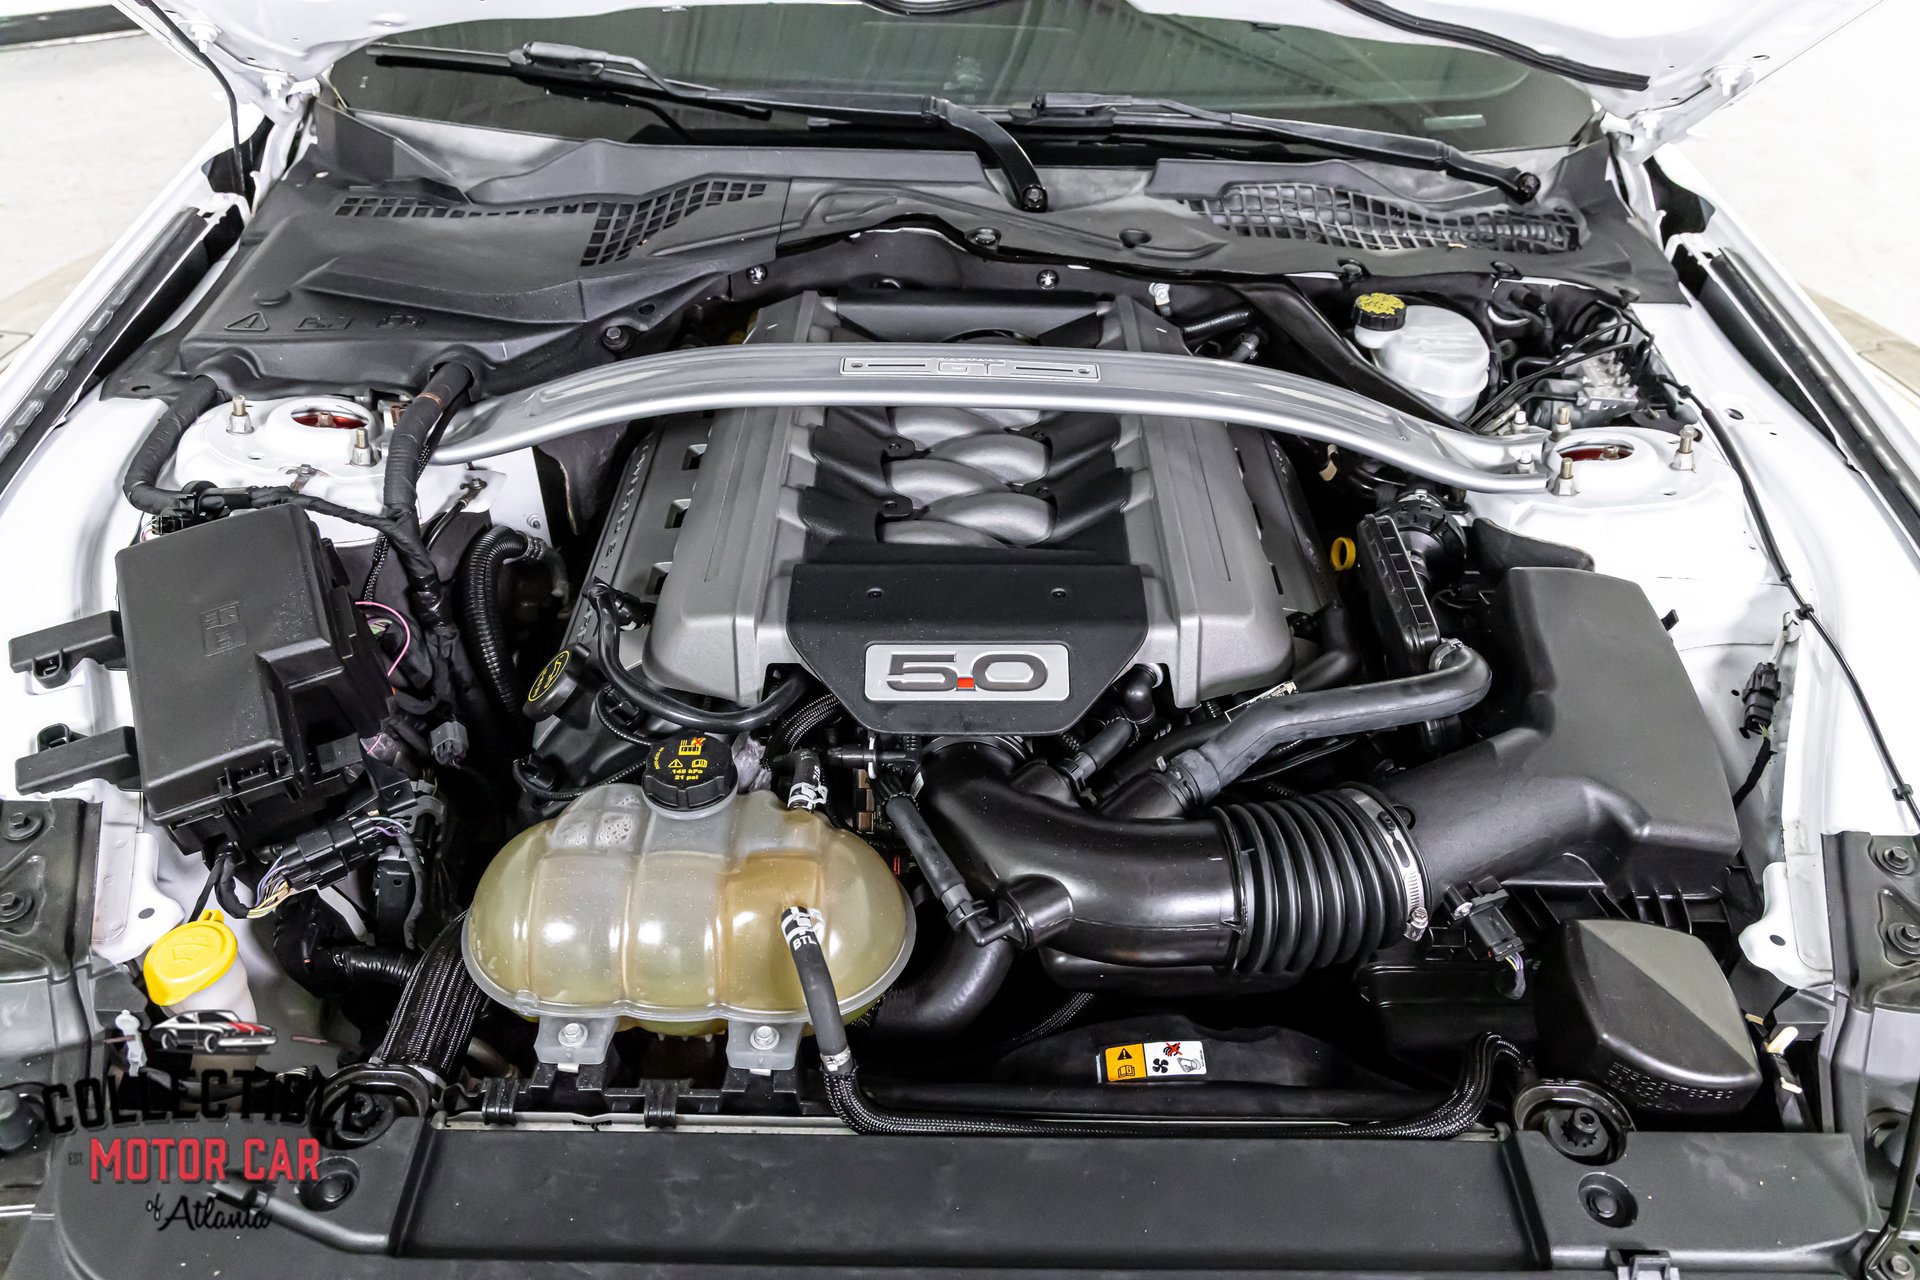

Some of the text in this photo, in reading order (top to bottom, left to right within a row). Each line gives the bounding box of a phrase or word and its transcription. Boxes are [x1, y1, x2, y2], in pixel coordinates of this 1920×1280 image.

[937, 360, 1006, 375] GT
[886, 651, 1049, 692] 5.0
[792, 935, 817, 951] BTL
